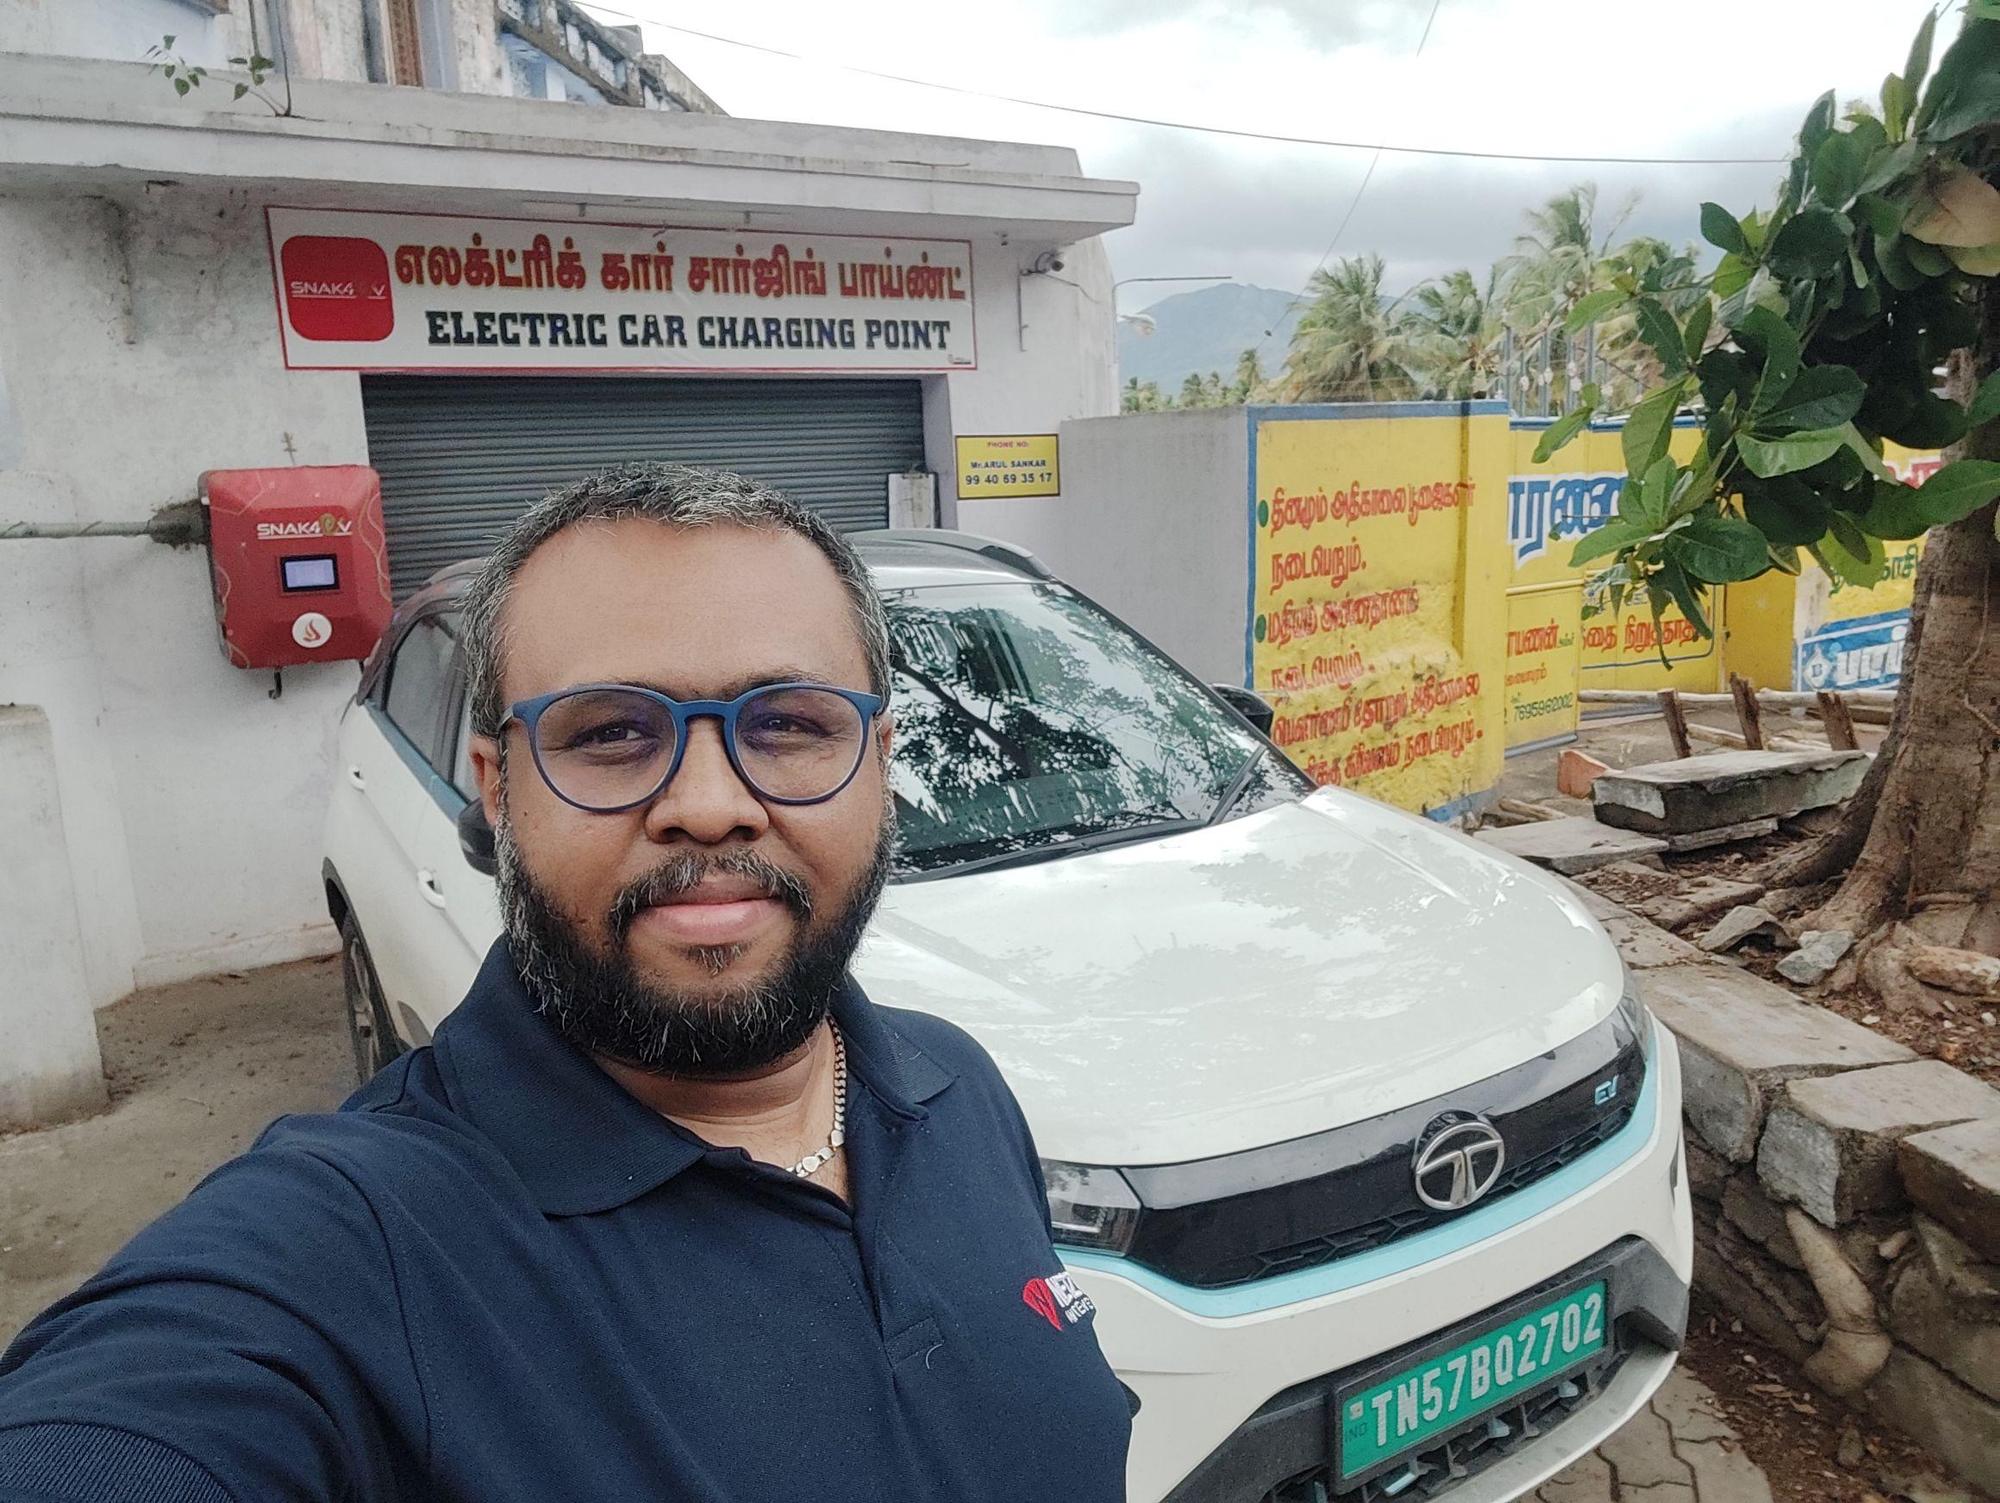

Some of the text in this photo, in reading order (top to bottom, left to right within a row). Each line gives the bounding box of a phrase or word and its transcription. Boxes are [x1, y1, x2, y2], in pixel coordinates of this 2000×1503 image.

[601, 240, 674, 291] கார்
[688, 243, 826, 298] சார்ஜிங்
[425, 311, 950, 350] ELECTRIC CAR CHARGING POINT
[987, 441, 1013, 449] PHONE
[1010, 460, 1046, 468] SANKAR
[1371, 1293, 1602, 1447] TN57BQ2702
